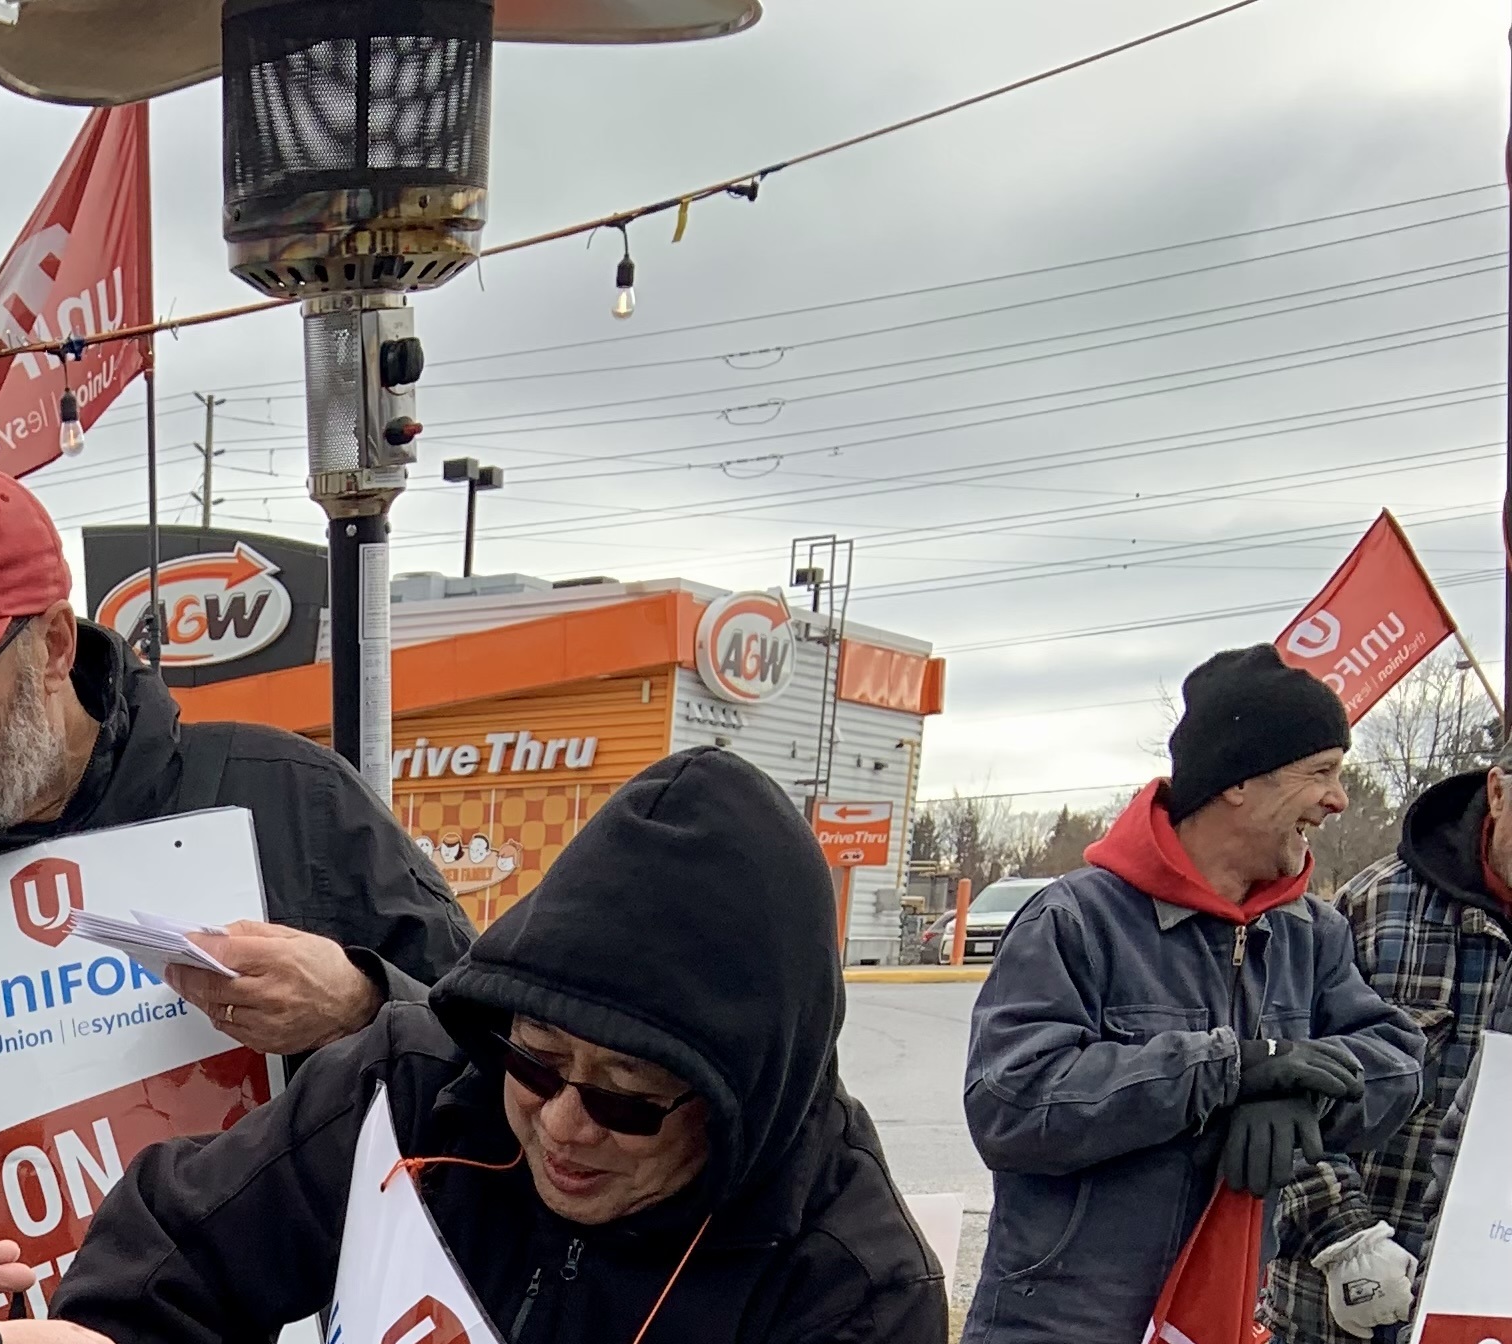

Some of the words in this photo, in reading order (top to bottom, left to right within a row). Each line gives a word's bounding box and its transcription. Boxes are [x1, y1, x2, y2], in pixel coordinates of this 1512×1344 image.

[127, 589, 272, 646] A&W
[719, 627, 789, 686] A&W
[392, 737, 481, 780] rive
[485, 730, 599, 774] Thru
[1, 1117, 125, 1239] ON
